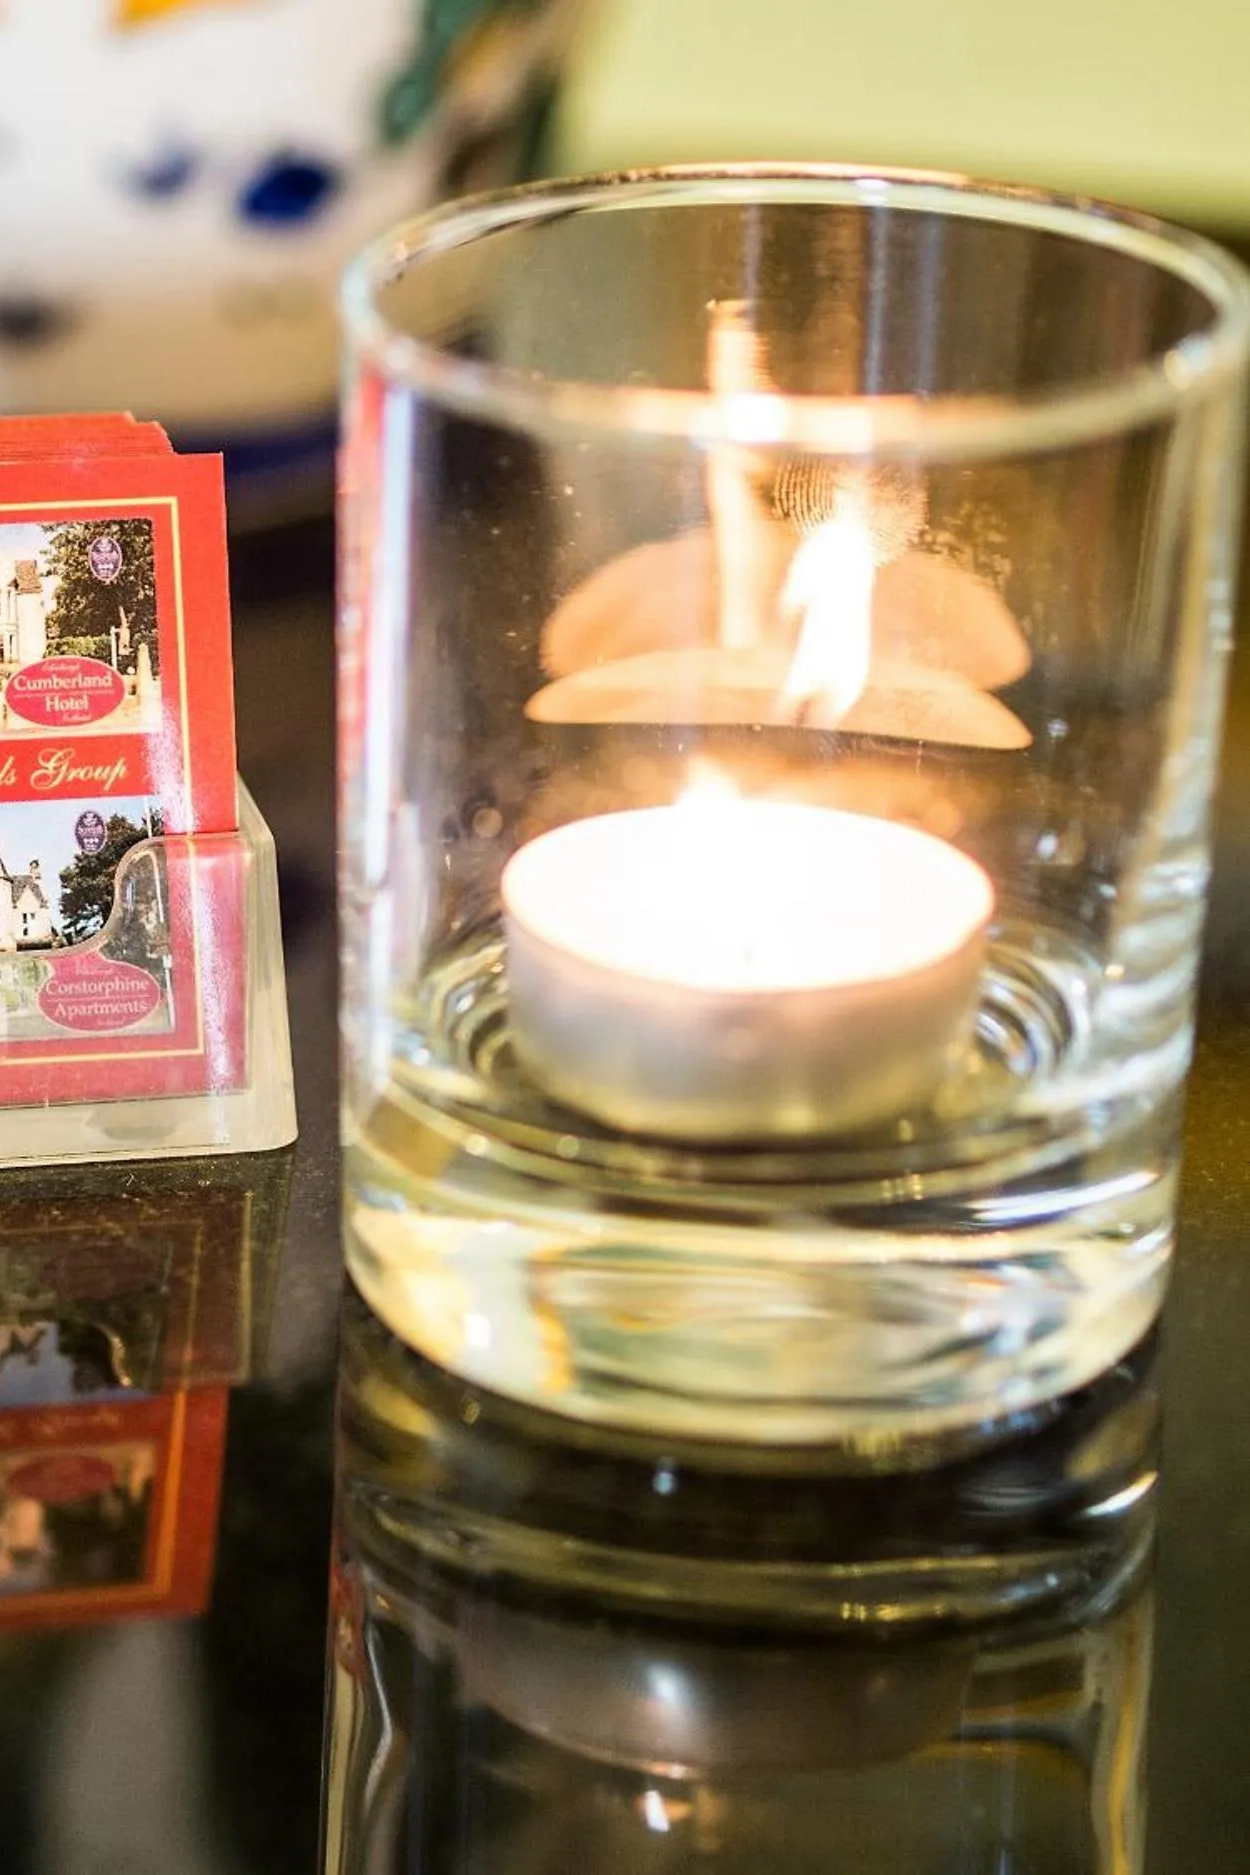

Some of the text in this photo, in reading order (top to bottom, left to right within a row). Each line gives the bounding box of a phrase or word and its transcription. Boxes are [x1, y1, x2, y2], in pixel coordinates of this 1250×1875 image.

[13, 671, 113, 692] Cumberland
[45, 693, 89, 713] Hotel
[30, 748, 129, 791] Group
[45, 976, 149, 997] Corstorphine
[53, 999, 149, 1020] Apartments
